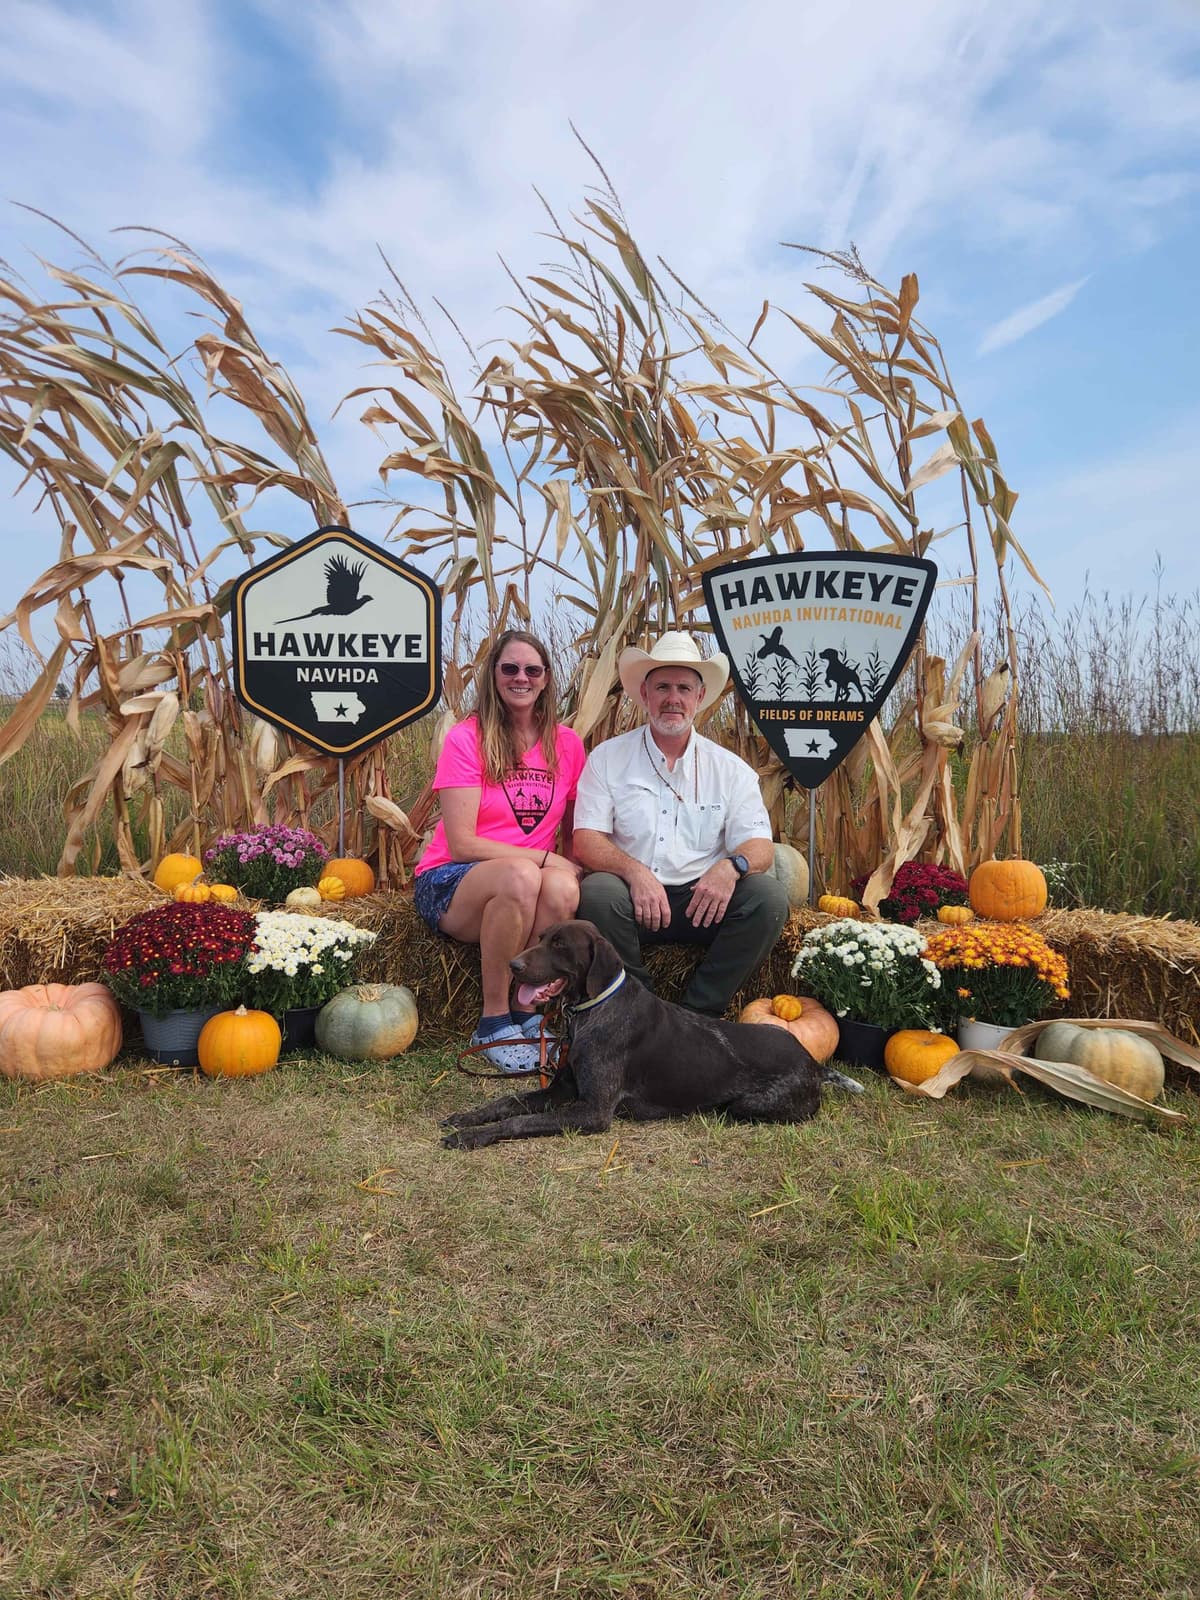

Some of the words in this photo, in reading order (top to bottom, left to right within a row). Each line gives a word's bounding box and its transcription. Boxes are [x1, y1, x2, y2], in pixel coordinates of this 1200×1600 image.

[719, 570, 919, 611] HAWKEYE
[732, 610, 793, 631] NAVHDA
[797, 606, 903, 630] INVITATIONAL
[253, 632, 422, 658] HAWKEYE
[296, 667, 379, 683] NAVHDA
[759, 709, 796, 721] FIELDS
[799, 709, 813, 721] OF
[816, 710, 865, 722] DREAMS
